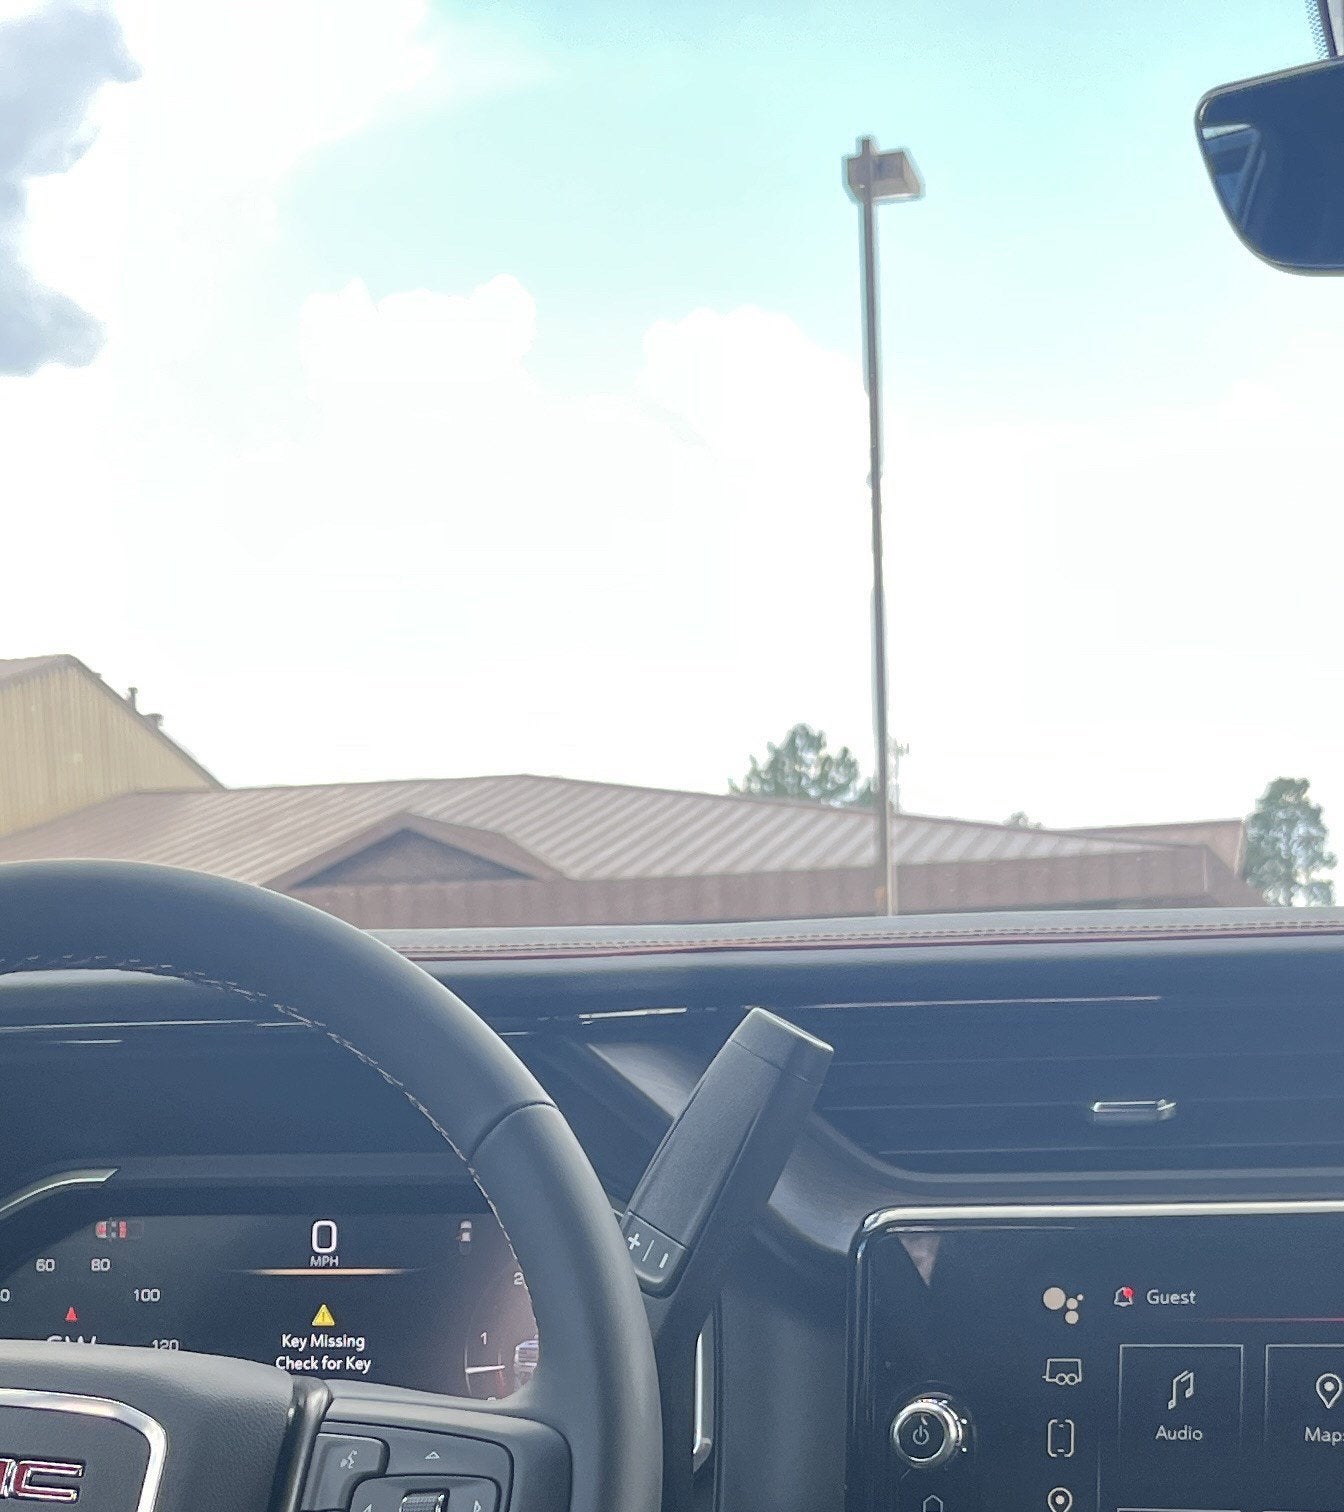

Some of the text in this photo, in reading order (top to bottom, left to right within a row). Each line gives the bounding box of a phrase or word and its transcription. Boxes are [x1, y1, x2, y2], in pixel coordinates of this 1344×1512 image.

[311, 1219, 338, 1253] 0
[35, 1258, 55, 1272] 60
[90, 1258, 111, 1272] 80
[309, 1255, 339, 1267] MPH
[133, 1288, 161, 1302] 100
[1146, 1289, 1197, 1306] Guest
[281, 1333, 366, 1351] Key Missing
[480, 1331, 488, 1345] 1
[275, 1355, 372, 1374] Check for Key
[1155, 1425, 1203, 1442] Audio
